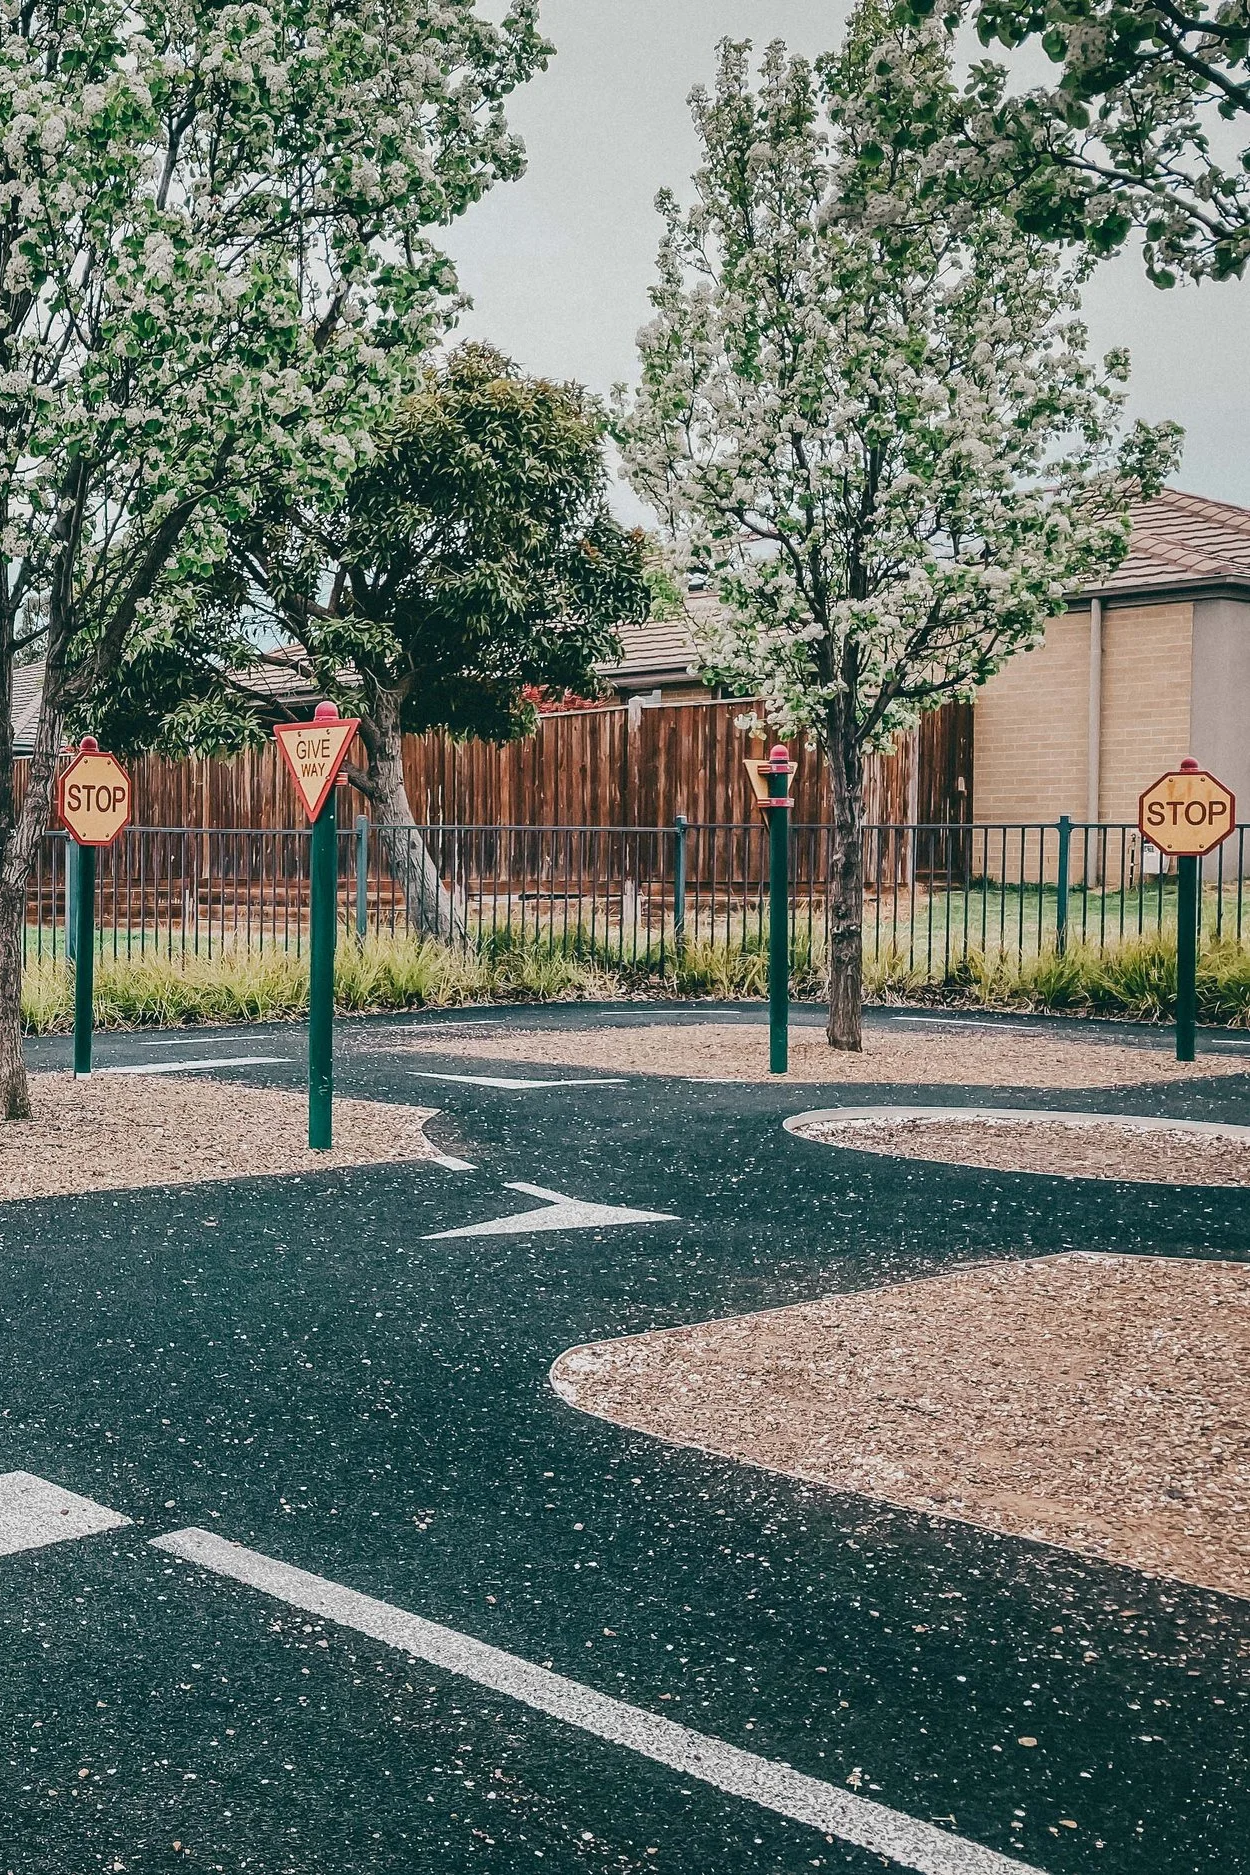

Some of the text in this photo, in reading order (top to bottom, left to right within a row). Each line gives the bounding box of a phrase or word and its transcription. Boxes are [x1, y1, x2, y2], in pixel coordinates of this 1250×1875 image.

[296, 739, 331, 760] GIVE
[301, 762, 326, 778] WAY
[67, 784, 126, 813] STOP
[1146, 800, 1227, 826] STOP
